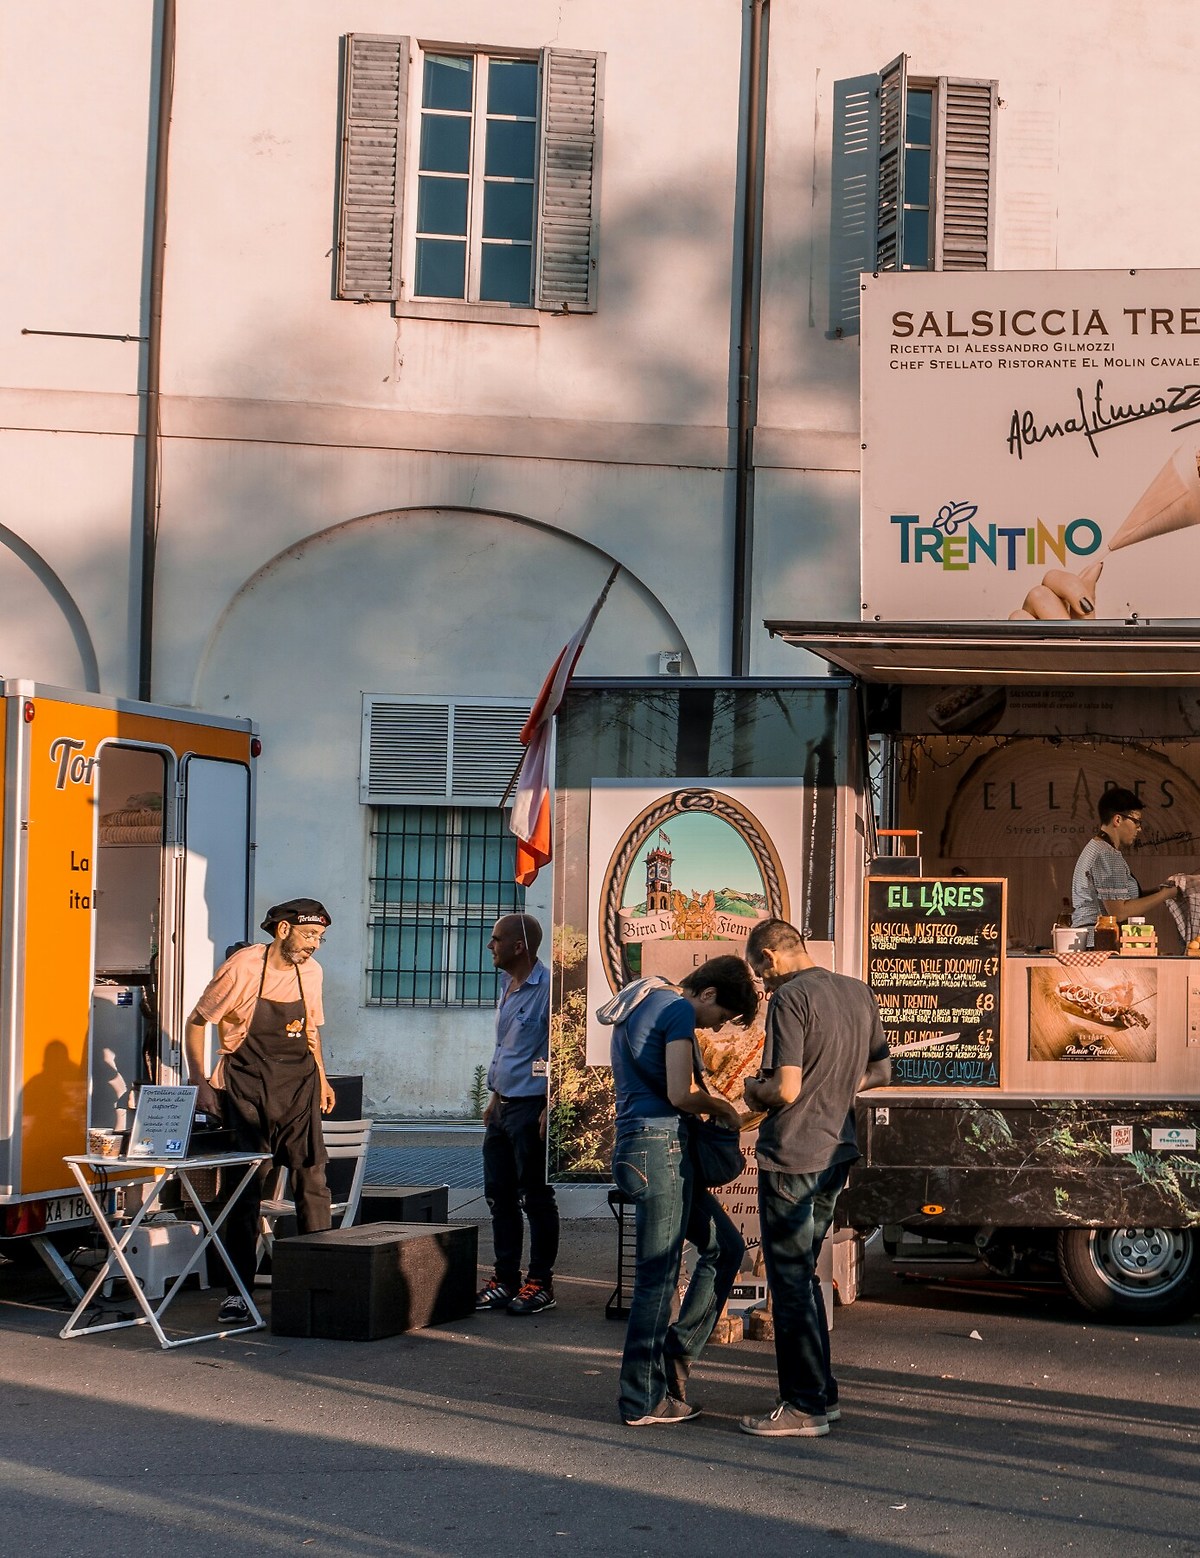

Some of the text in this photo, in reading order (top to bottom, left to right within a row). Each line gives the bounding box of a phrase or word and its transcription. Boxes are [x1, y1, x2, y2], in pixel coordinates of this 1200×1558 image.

[892, 309, 1109, 337] SALSICCIA
[890, 342, 1115, 354] RICETTA DI ALESSANDRO GILMOZZI
[889, 360, 924, 369] CHEF
[929, 359, 993, 369] STELLATO
[999, 358, 1077, 369] RISTORANTE
[1082, 358, 1098, 368] EL
[1104, 358, 1145, 367] MOLIN
[890, 514, 1103, 571] TRENTINO
[984, 782, 1022, 810] EL
[1006, 824, 1046, 835] Street
[1053, 824, 1085, 835] Food
[888, 882, 985, 915] EL LARES
[622, 915, 752, 938] Birra di Fiem
[870, 922, 910, 937] SALSICCIA
[982, 924, 998, 940] €6
[871, 957, 999, 976] CROSTONE DELLE DOLOMITI €7
[903, 994, 938, 1009] TRENTIN
[976, 993, 994, 1011] €8
[1066, 1044, 1118, 1056] Panin Trentin
[896, 1060, 942, 1079] STELLATO
[945, 1060, 984, 1079] GILMOZZI
[732, 1203, 743, 1214] di
